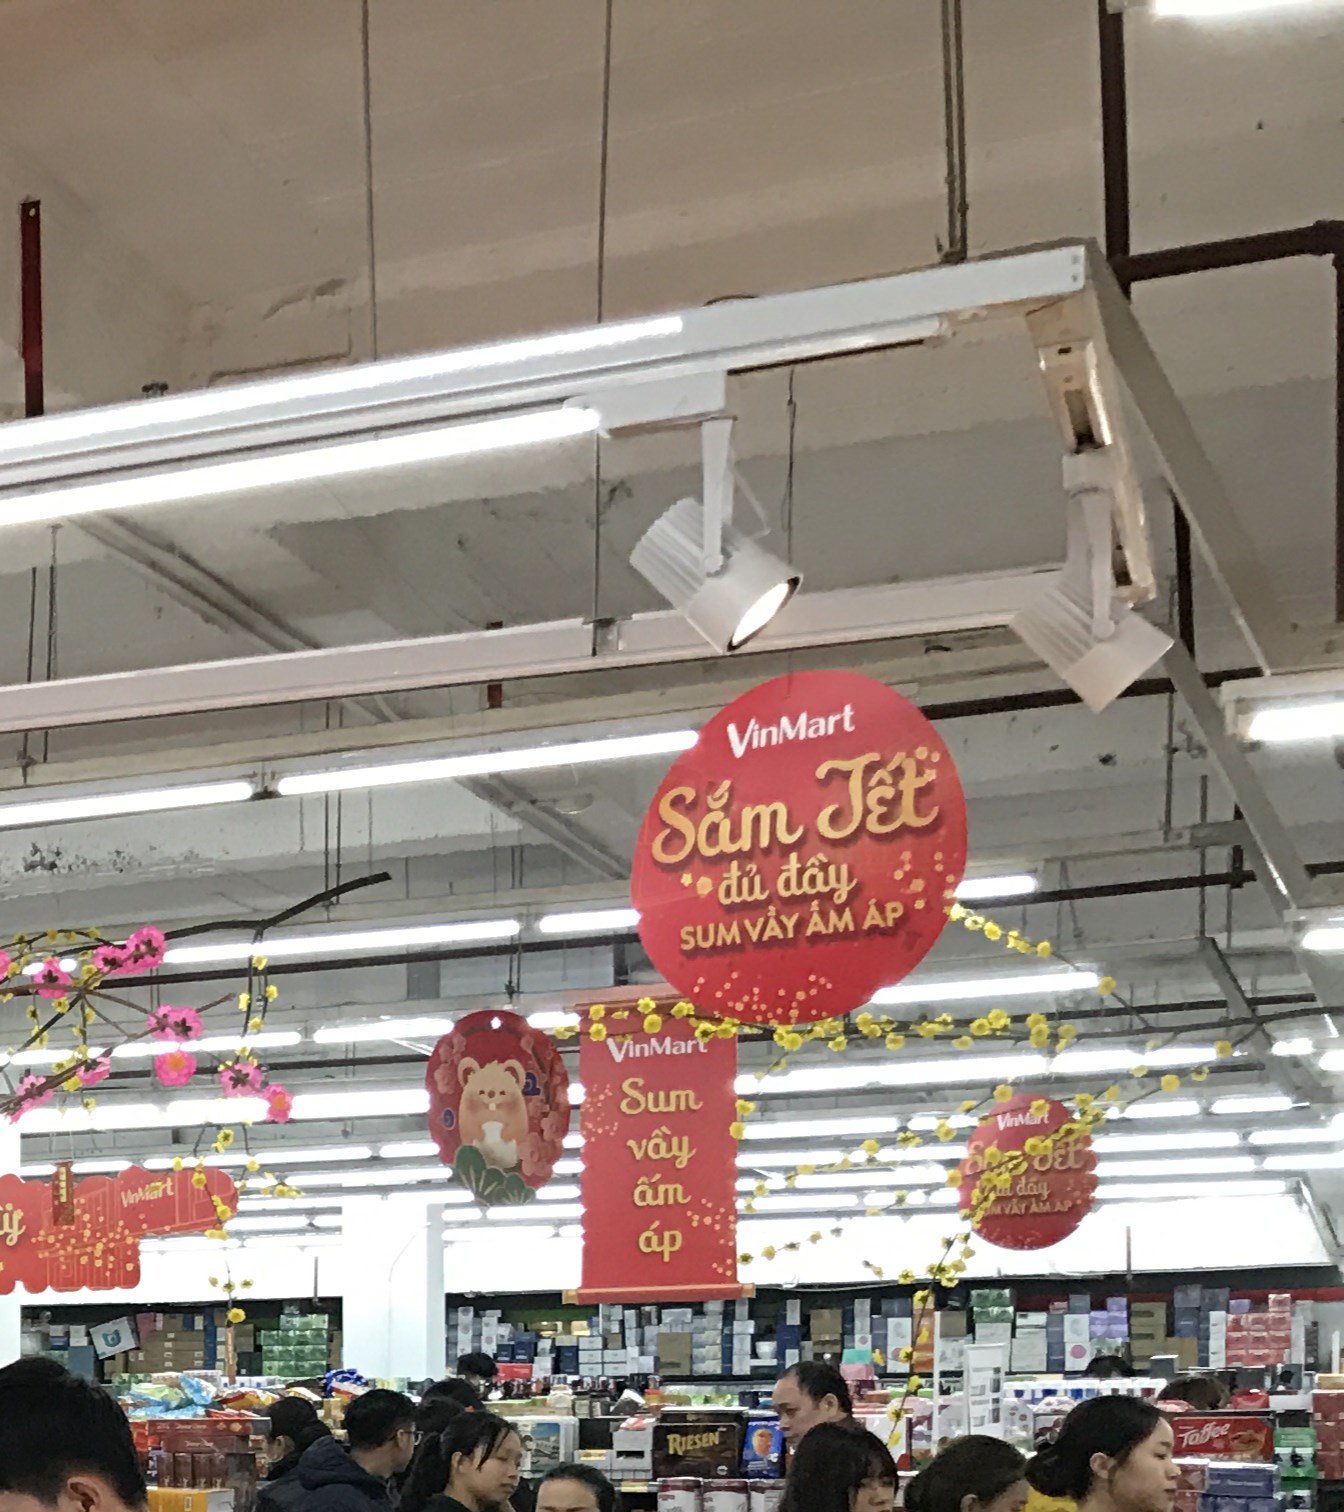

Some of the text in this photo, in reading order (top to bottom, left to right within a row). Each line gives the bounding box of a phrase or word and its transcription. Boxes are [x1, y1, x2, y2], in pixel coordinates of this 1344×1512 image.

[727, 704, 855, 759] VinMart
[652, 750, 939, 864] Sắm Tết
[718, 852, 858, 906] đủ đầy
[680, 898, 904, 951] SUM VẦY ẤM ÁP
[607, 1035, 708, 1063] VinMart
[620, 1077, 704, 1115] Sum
[627, 1126, 696, 1170] vầy
[633, 1173, 692, 1208] ấm
[639, 1220, 683, 1262] áp
[667, 1431, 720, 1455] RIESEN
[1177, 1422, 1231, 1448] Toffee
